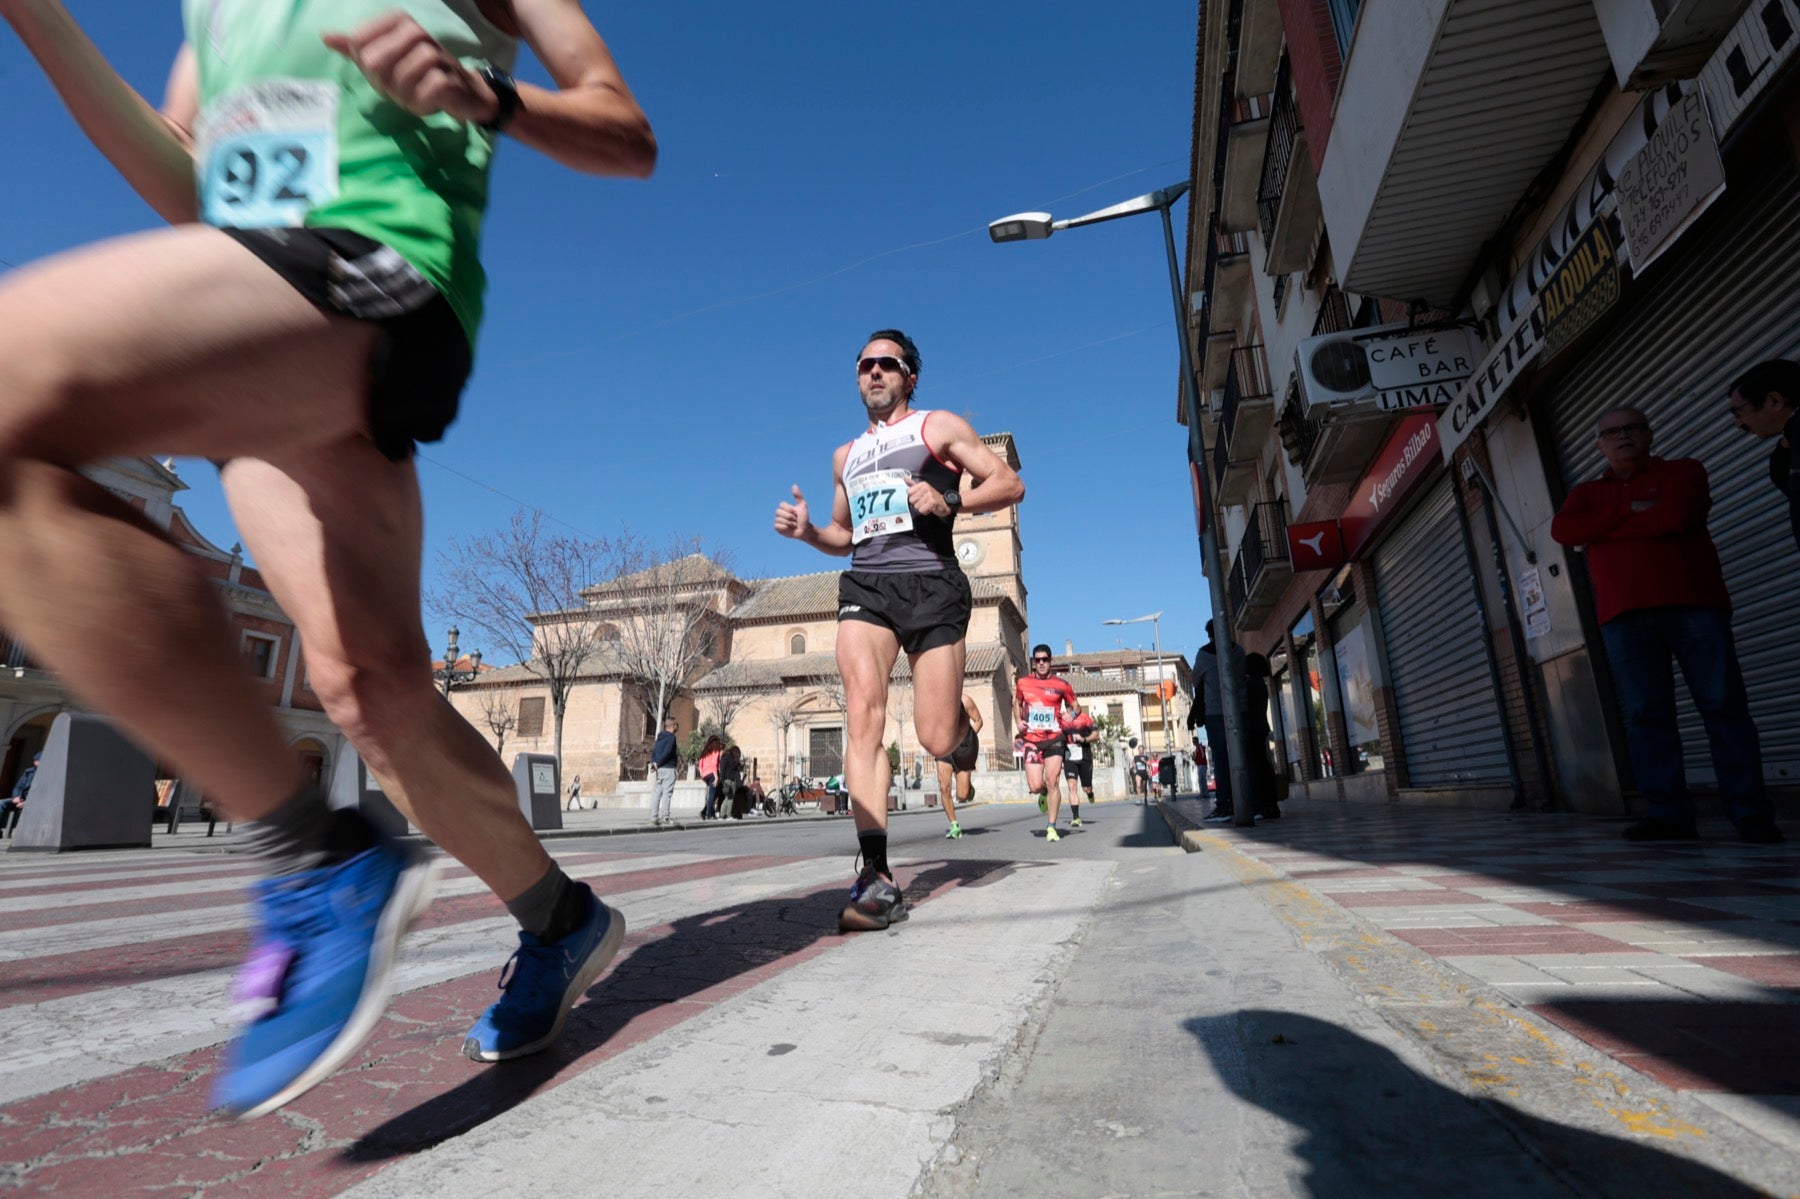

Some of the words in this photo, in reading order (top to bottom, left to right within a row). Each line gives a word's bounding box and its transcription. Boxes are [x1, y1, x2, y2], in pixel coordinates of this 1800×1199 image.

[222, 143, 308, 206] 92
[1543, 227, 1612, 325] ALQUILA
[1371, 337, 1439, 363] CAFÉ
[1418, 357, 1469, 377] BAR
[1380, 381, 1467, 410] LIMA
[1377, 457, 1406, 504] Seguros
[1403, 422, 1431, 468] Bilbao
[857, 488, 896, 520] 377
[1033, 713, 1050, 722] 405
